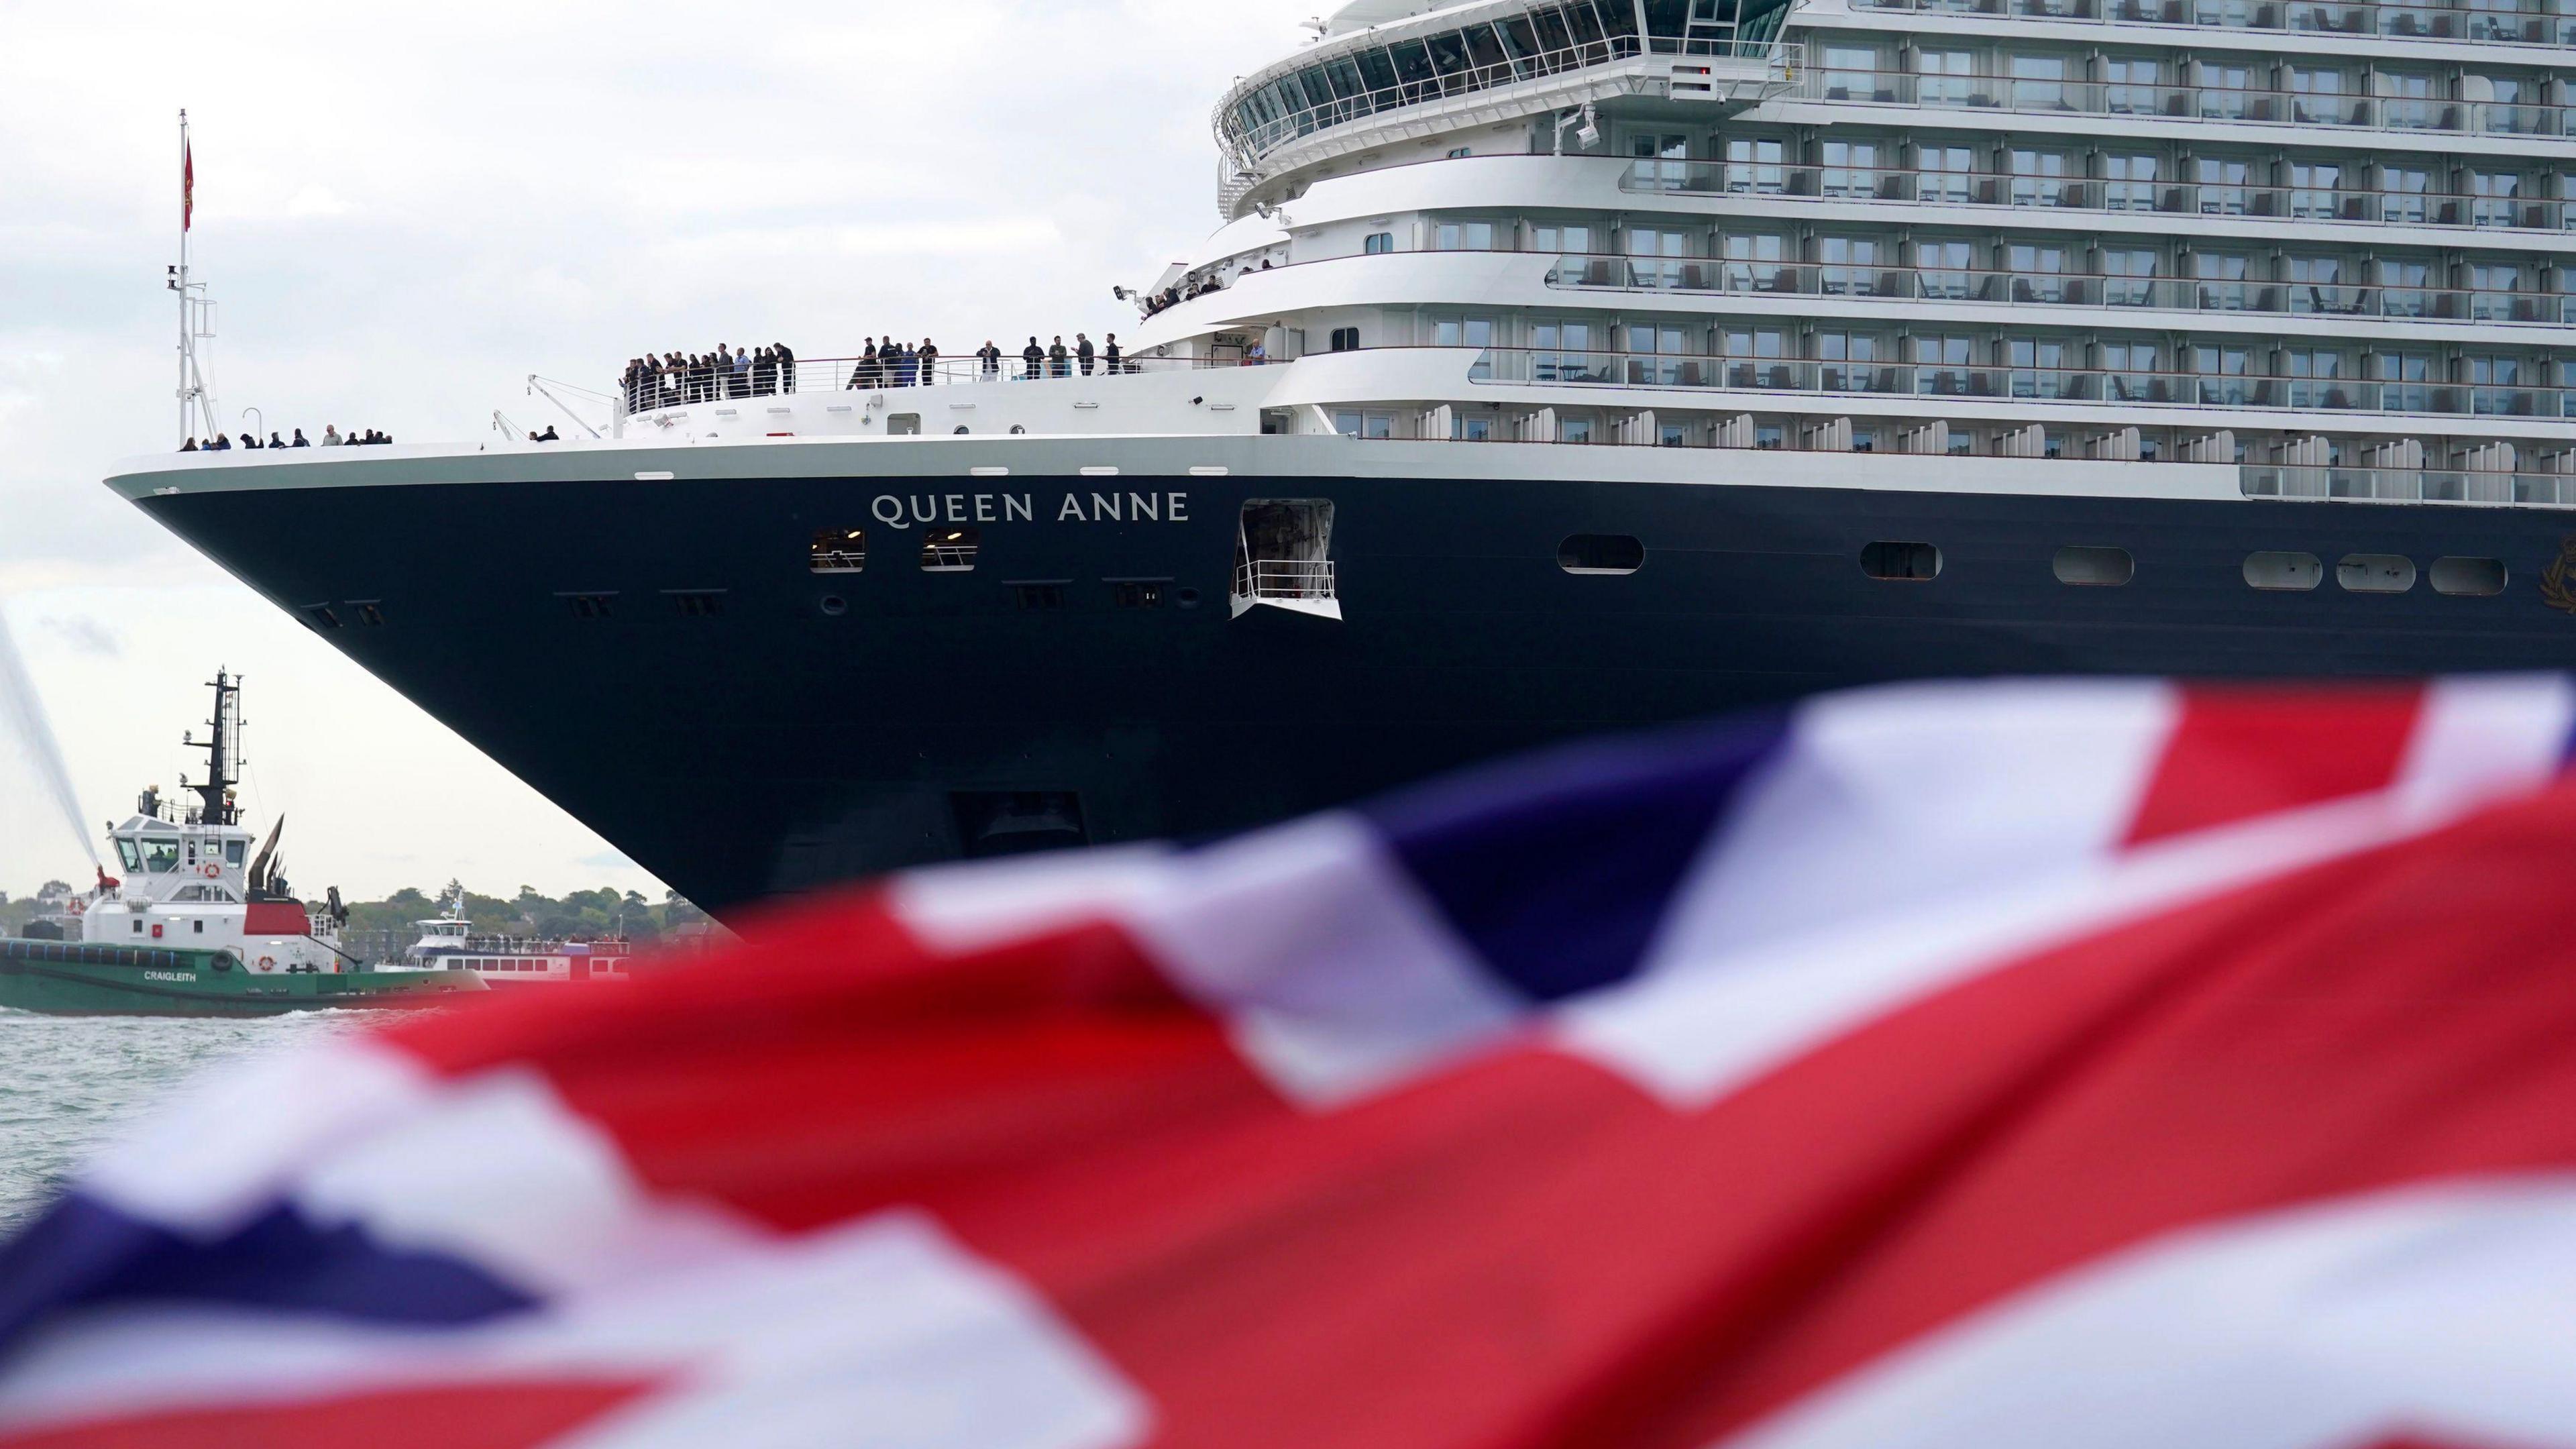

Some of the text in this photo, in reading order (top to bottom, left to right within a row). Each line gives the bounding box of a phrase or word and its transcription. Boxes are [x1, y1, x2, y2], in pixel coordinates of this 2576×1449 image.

[871, 492, 1189, 529] QUEEN ANNE
[144, 971, 196, 982] CRAIGLEITH
